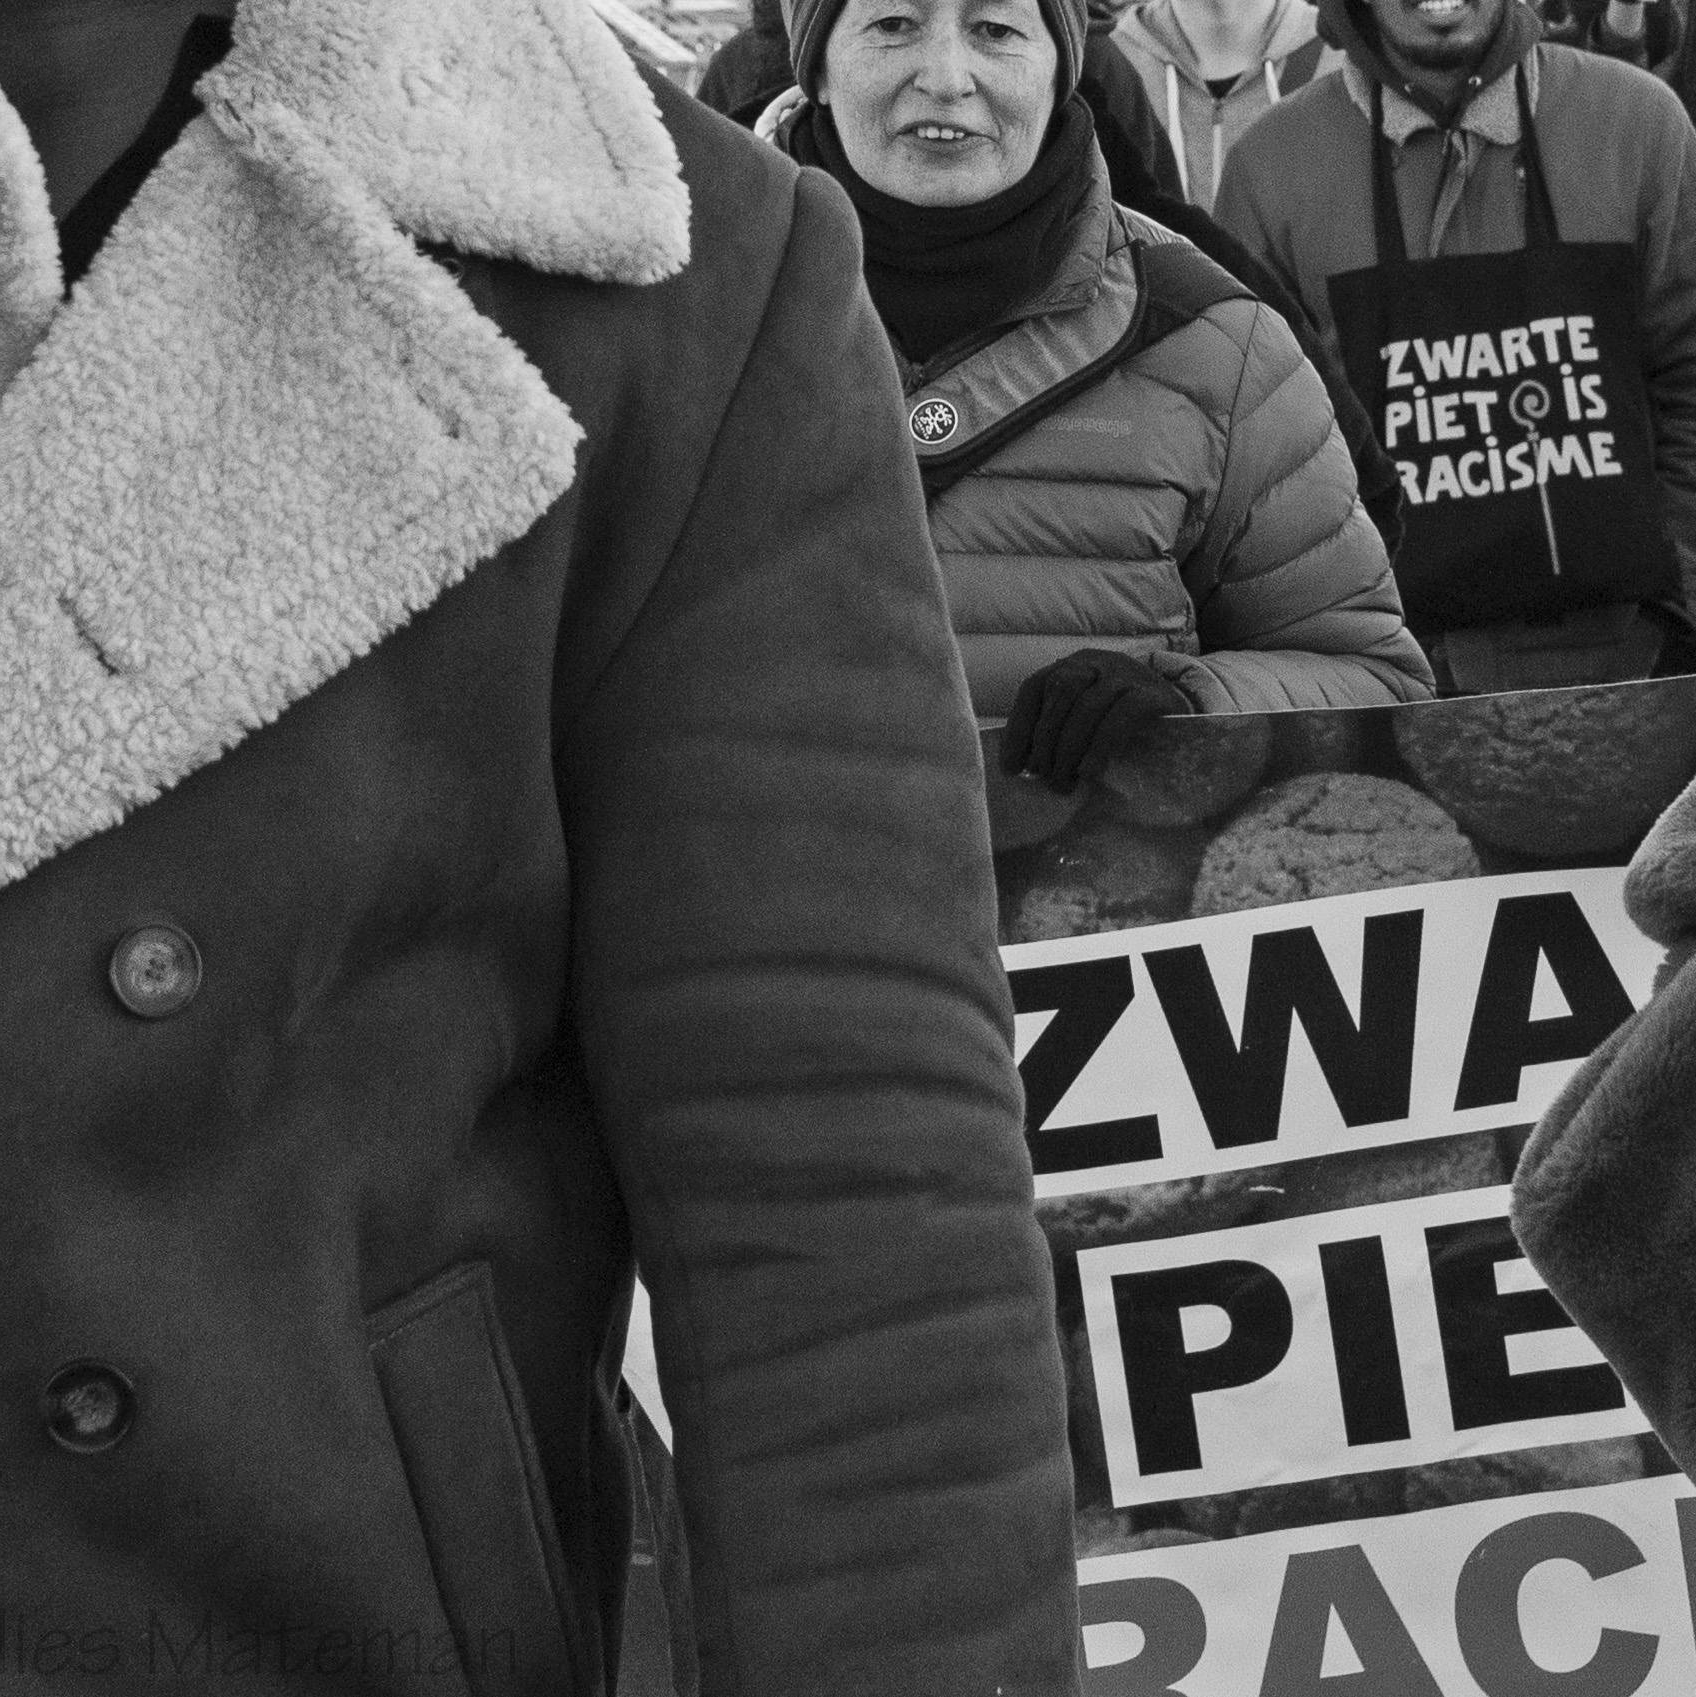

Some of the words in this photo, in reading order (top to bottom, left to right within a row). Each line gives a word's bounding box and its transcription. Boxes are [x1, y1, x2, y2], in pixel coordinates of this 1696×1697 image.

[1380, 315, 1599, 388] ZWARTE
[1386, 386, 1498, 448] PIET
[1560, 363, 1607, 421] IS
[1395, 431, 1623, 504] RACISME
